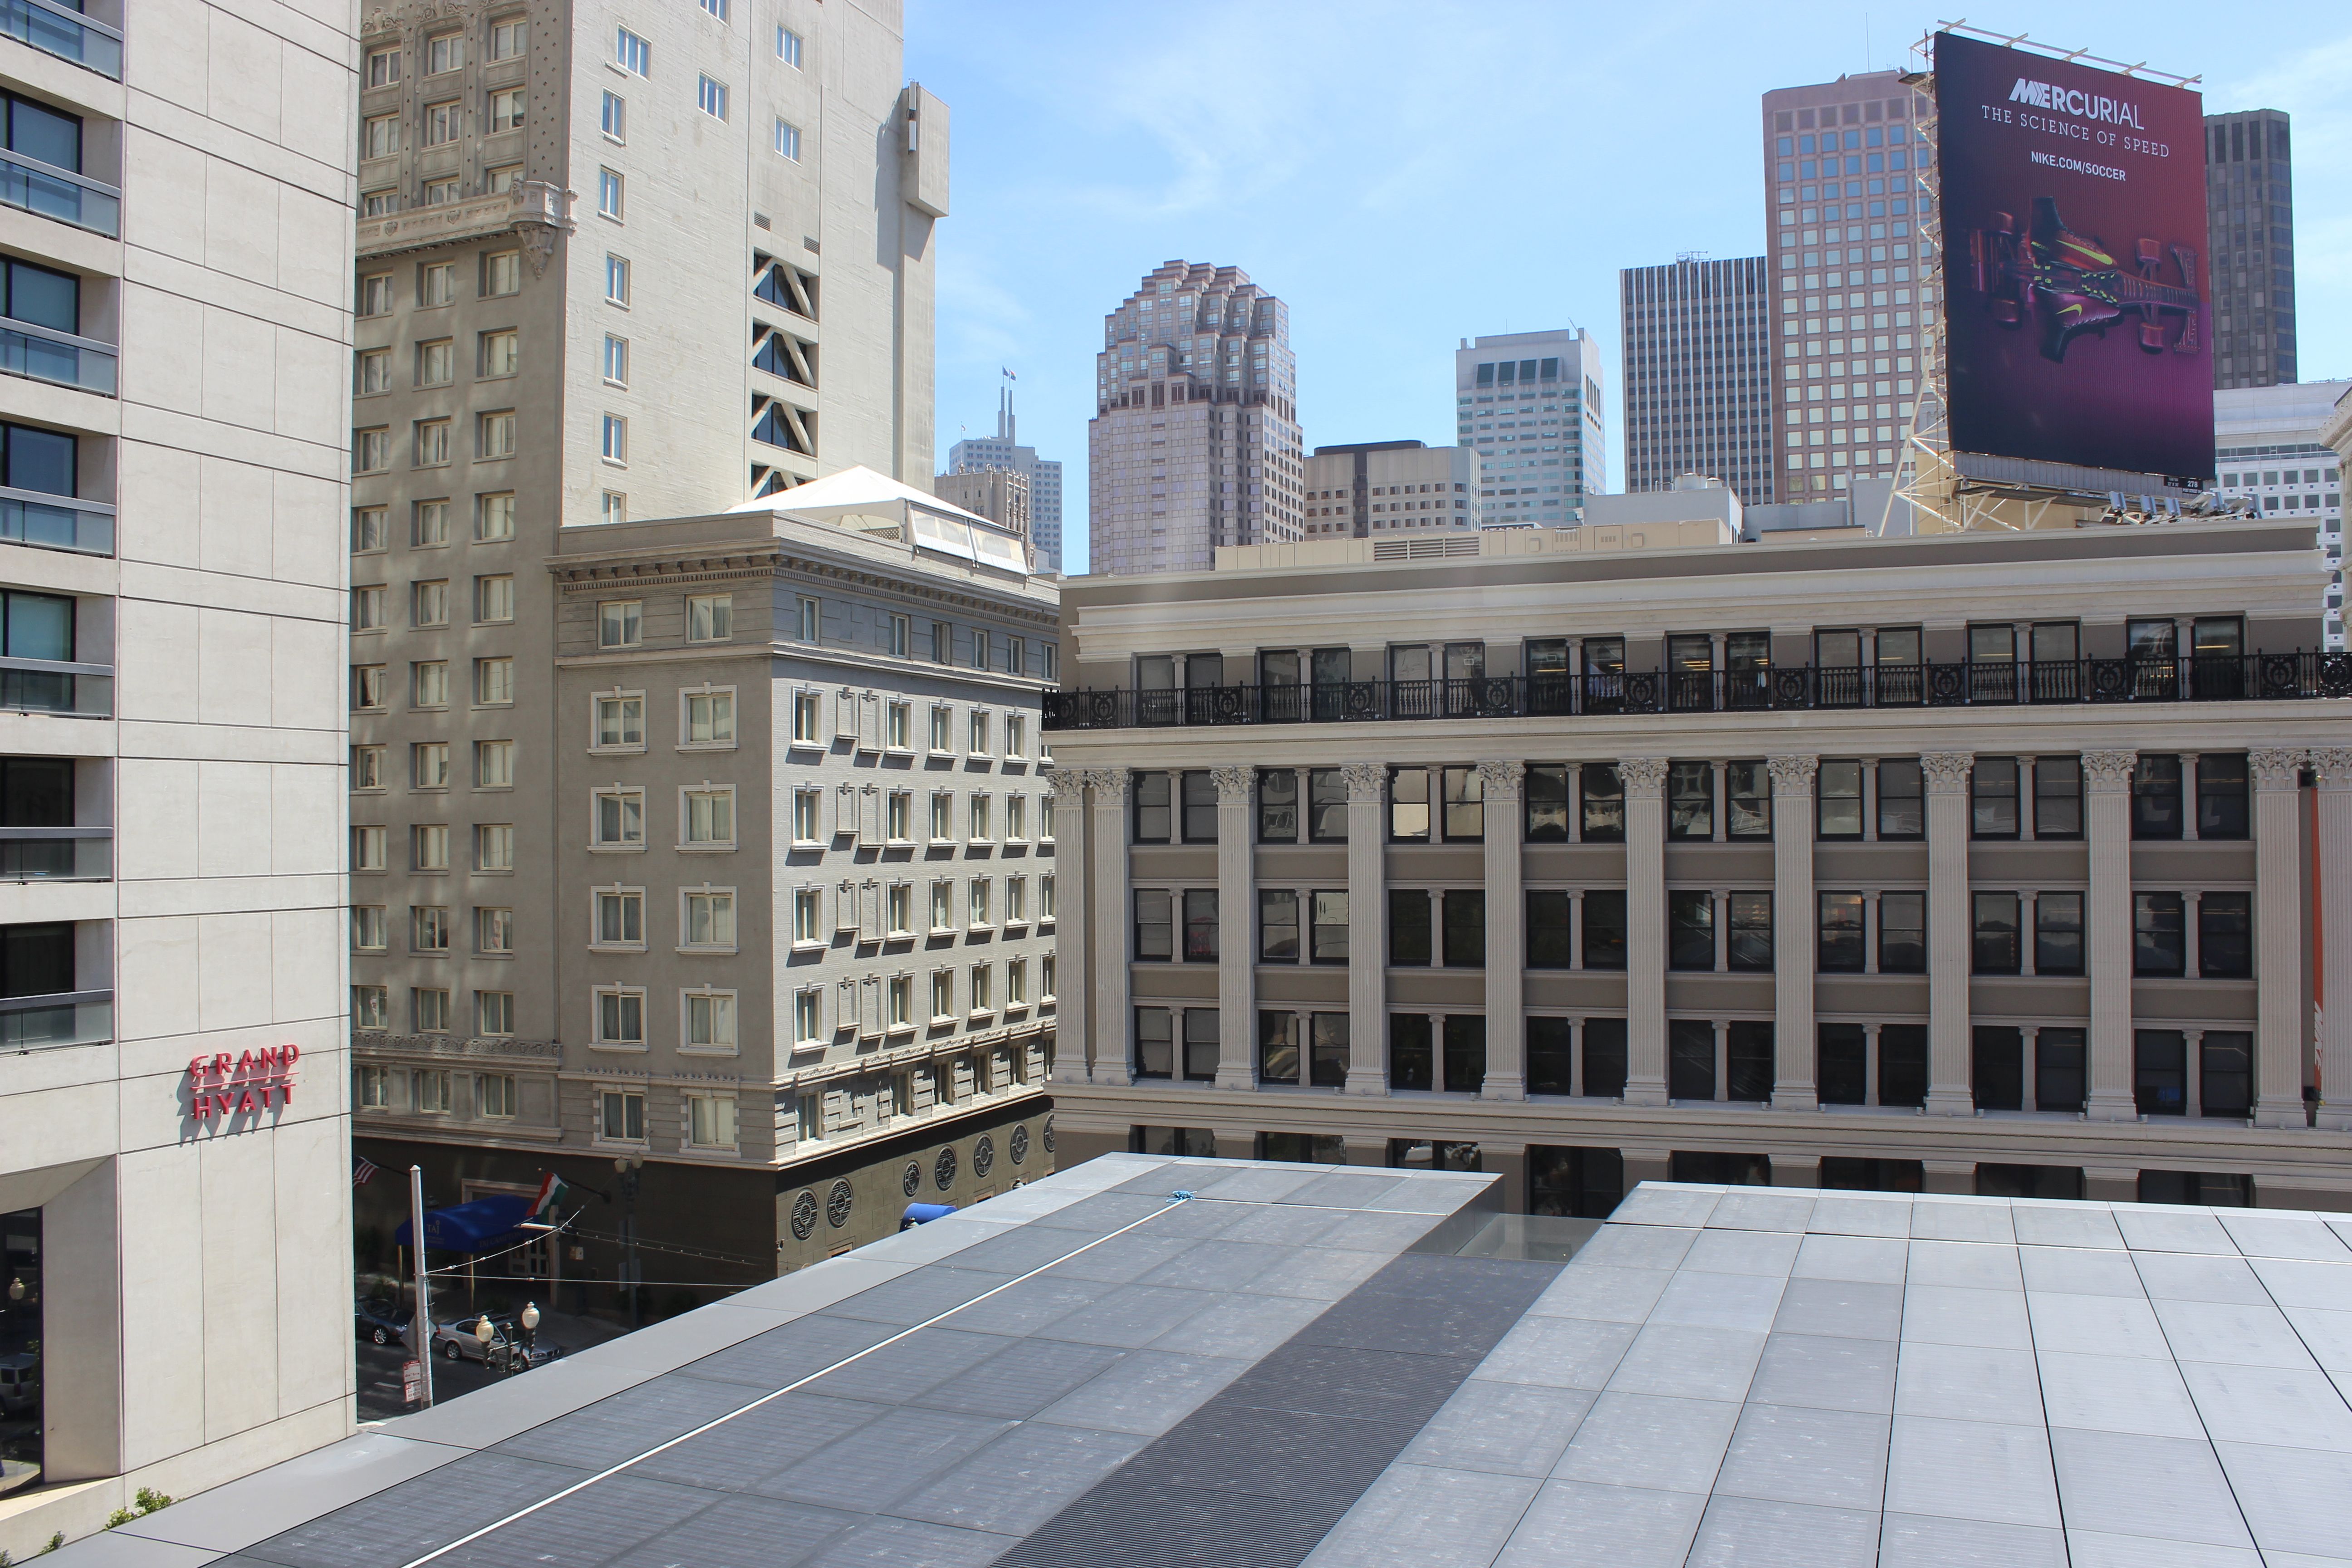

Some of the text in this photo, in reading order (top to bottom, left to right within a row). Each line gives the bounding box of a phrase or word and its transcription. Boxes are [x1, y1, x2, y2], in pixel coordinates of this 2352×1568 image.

[2009, 78, 2145, 130] MERCURIAL
[1982, 105, 2169, 157] THE SCIENCE OF SPEED
[2031, 151, 2126, 181] NIKE.COM/SOCCER
[190, 1044, 300, 1078] GRAND
[193, 1083, 297, 1120] HYATT
